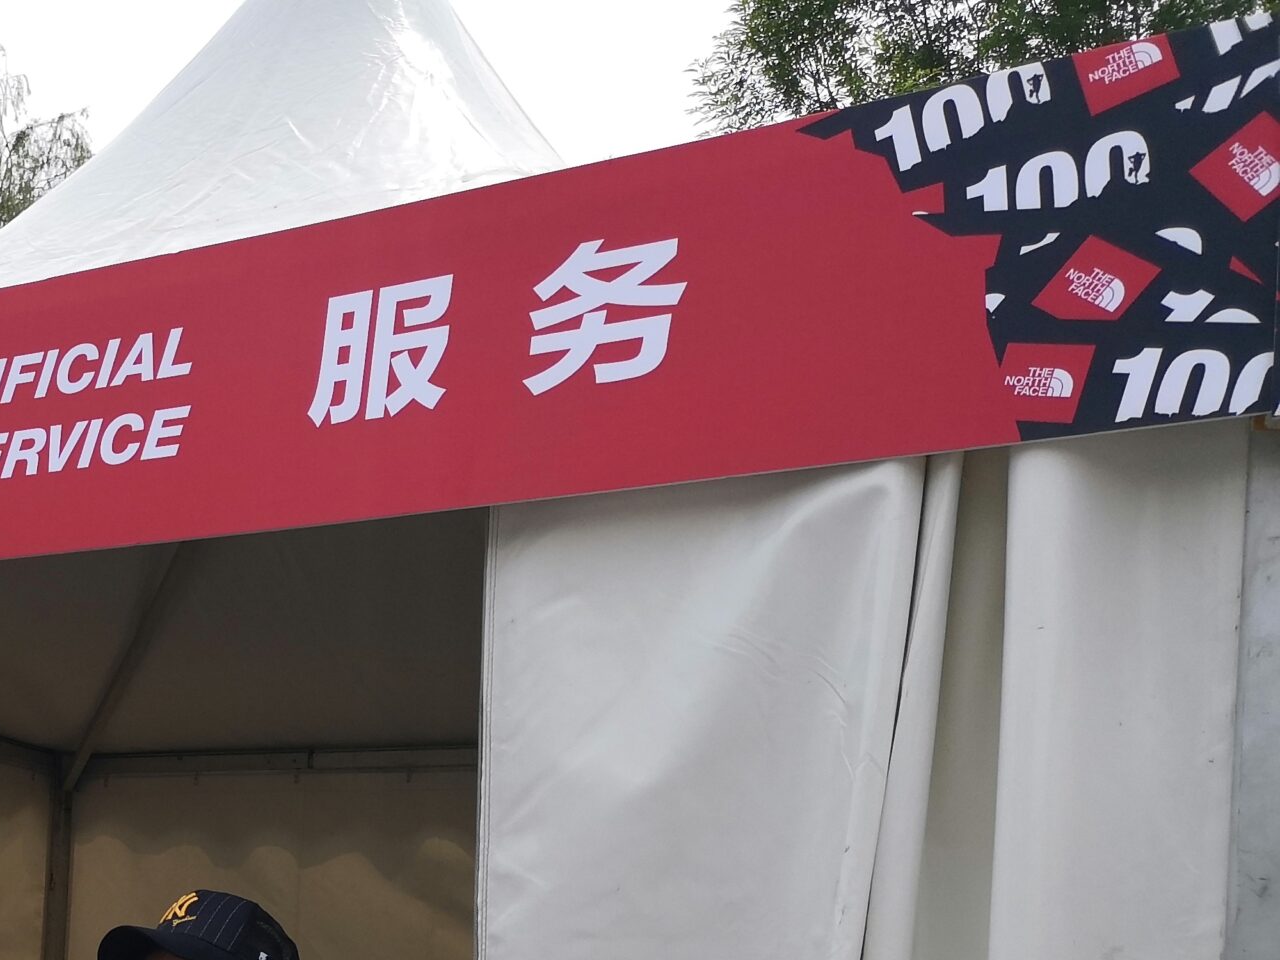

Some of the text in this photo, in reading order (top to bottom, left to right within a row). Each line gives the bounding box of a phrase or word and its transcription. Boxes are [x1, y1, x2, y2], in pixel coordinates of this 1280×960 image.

[1105, 46, 1133, 64] THE
[1088, 54, 1137, 83] NORTH
[1104, 65, 1139, 85] FACE
[874, 62, 1052, 172] 100
[1229, 142, 1267, 175] NORTH
[1253, 145, 1277, 168] THE
[966, 130, 1151, 212] 100
[1228, 157, 1257, 183] FACE
[1065, 268, 1108, 294] NORTH
[1090, 267, 1116, 286] THE
[1067, 282, 1100, 303] FACE
[307, 238, 689, 428] 服务
[1004, 375, 1051, 387] NORTH
[1028, 367, 1054, 378] THE
[1013, 385, 1048, 397] FACE
